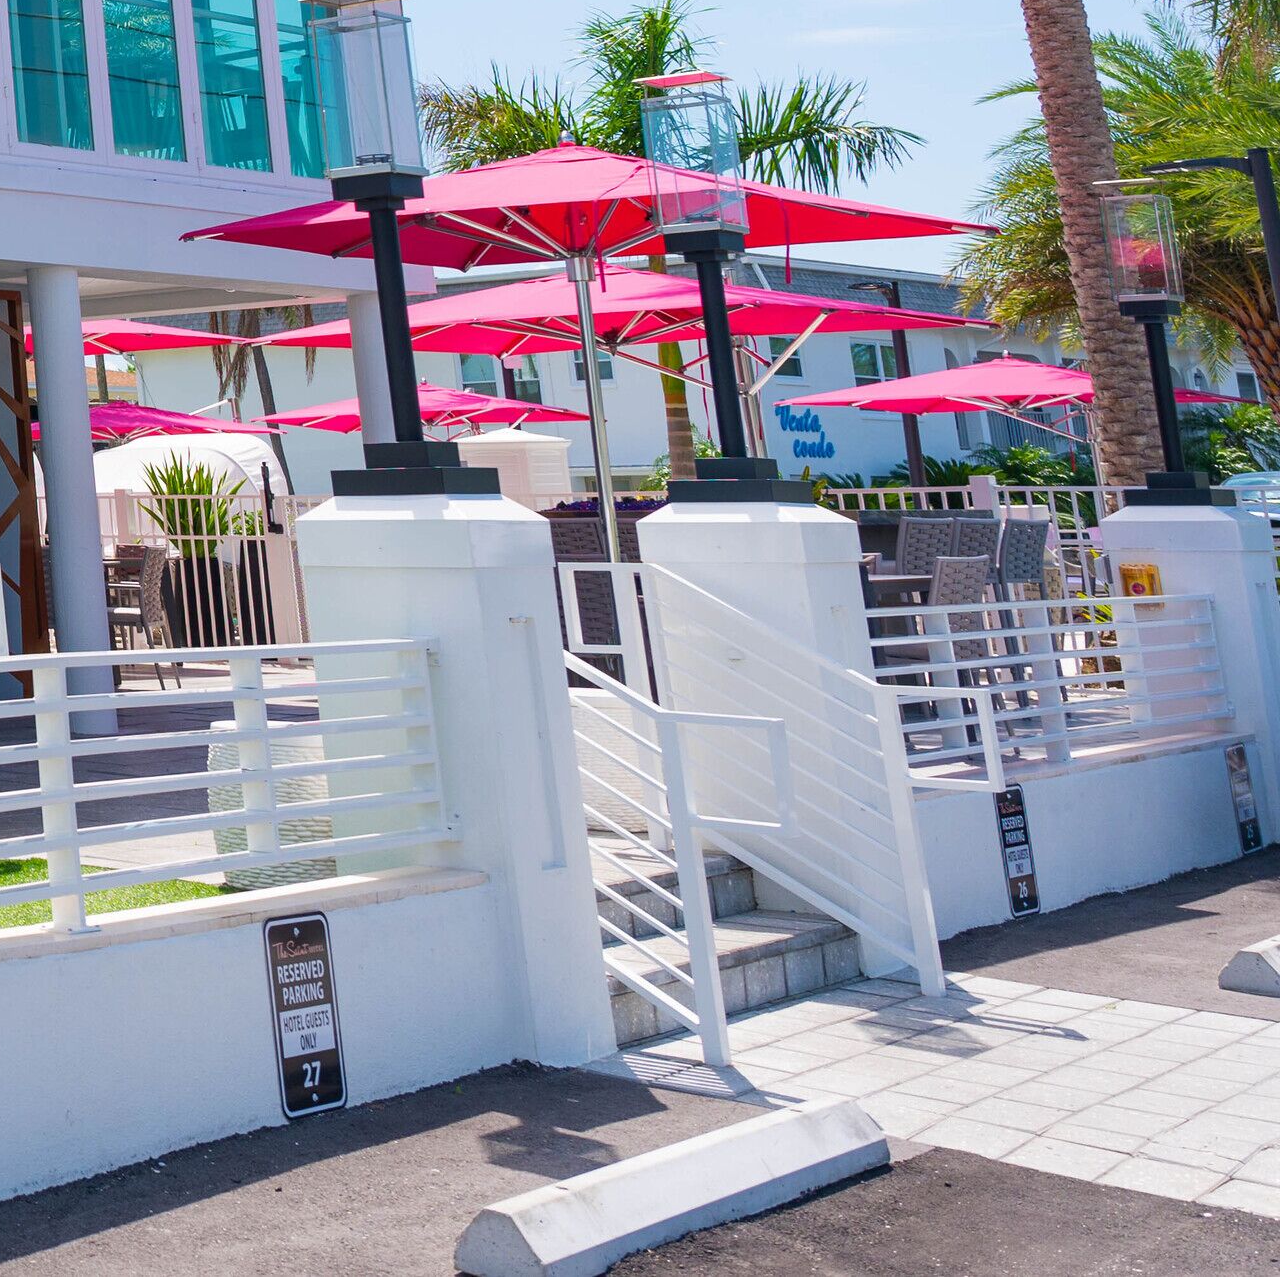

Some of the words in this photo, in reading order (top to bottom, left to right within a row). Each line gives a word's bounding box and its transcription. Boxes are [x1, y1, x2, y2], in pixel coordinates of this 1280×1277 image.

[1018, 881, 1028, 898] 26
[277, 959, 325, 984] RESERVED
[282, 981, 325, 1005] PARKING
[283, 1014, 305, 1033] HOTEL
[305, 1010, 330, 1030] GUESTS
[300, 1032, 317, 1051] ONLY
[302, 1060, 321, 1088] 27
